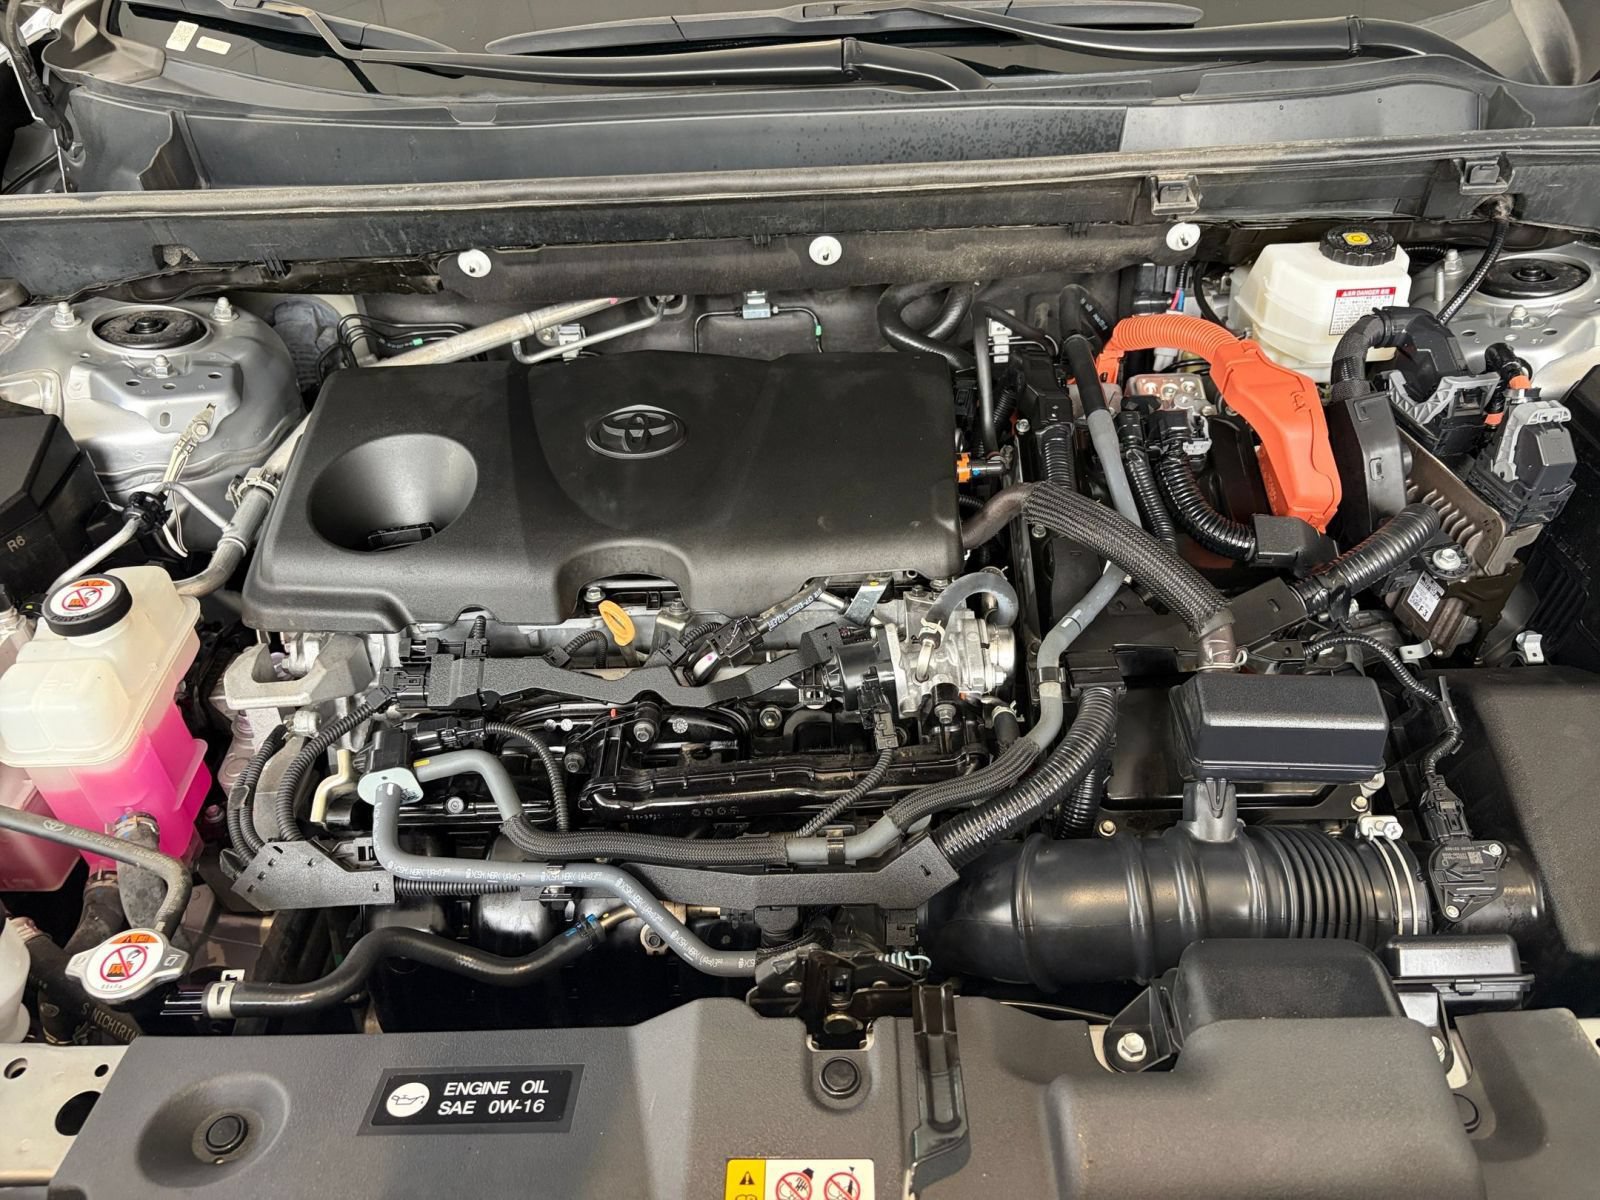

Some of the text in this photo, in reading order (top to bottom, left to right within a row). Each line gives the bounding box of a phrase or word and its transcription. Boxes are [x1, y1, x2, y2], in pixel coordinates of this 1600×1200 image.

[7, 535, 26, 552] R6
[443, 1080, 550, 1096] ENGINE OIL
[437, 1098, 546, 1116] SAE 0W-16
